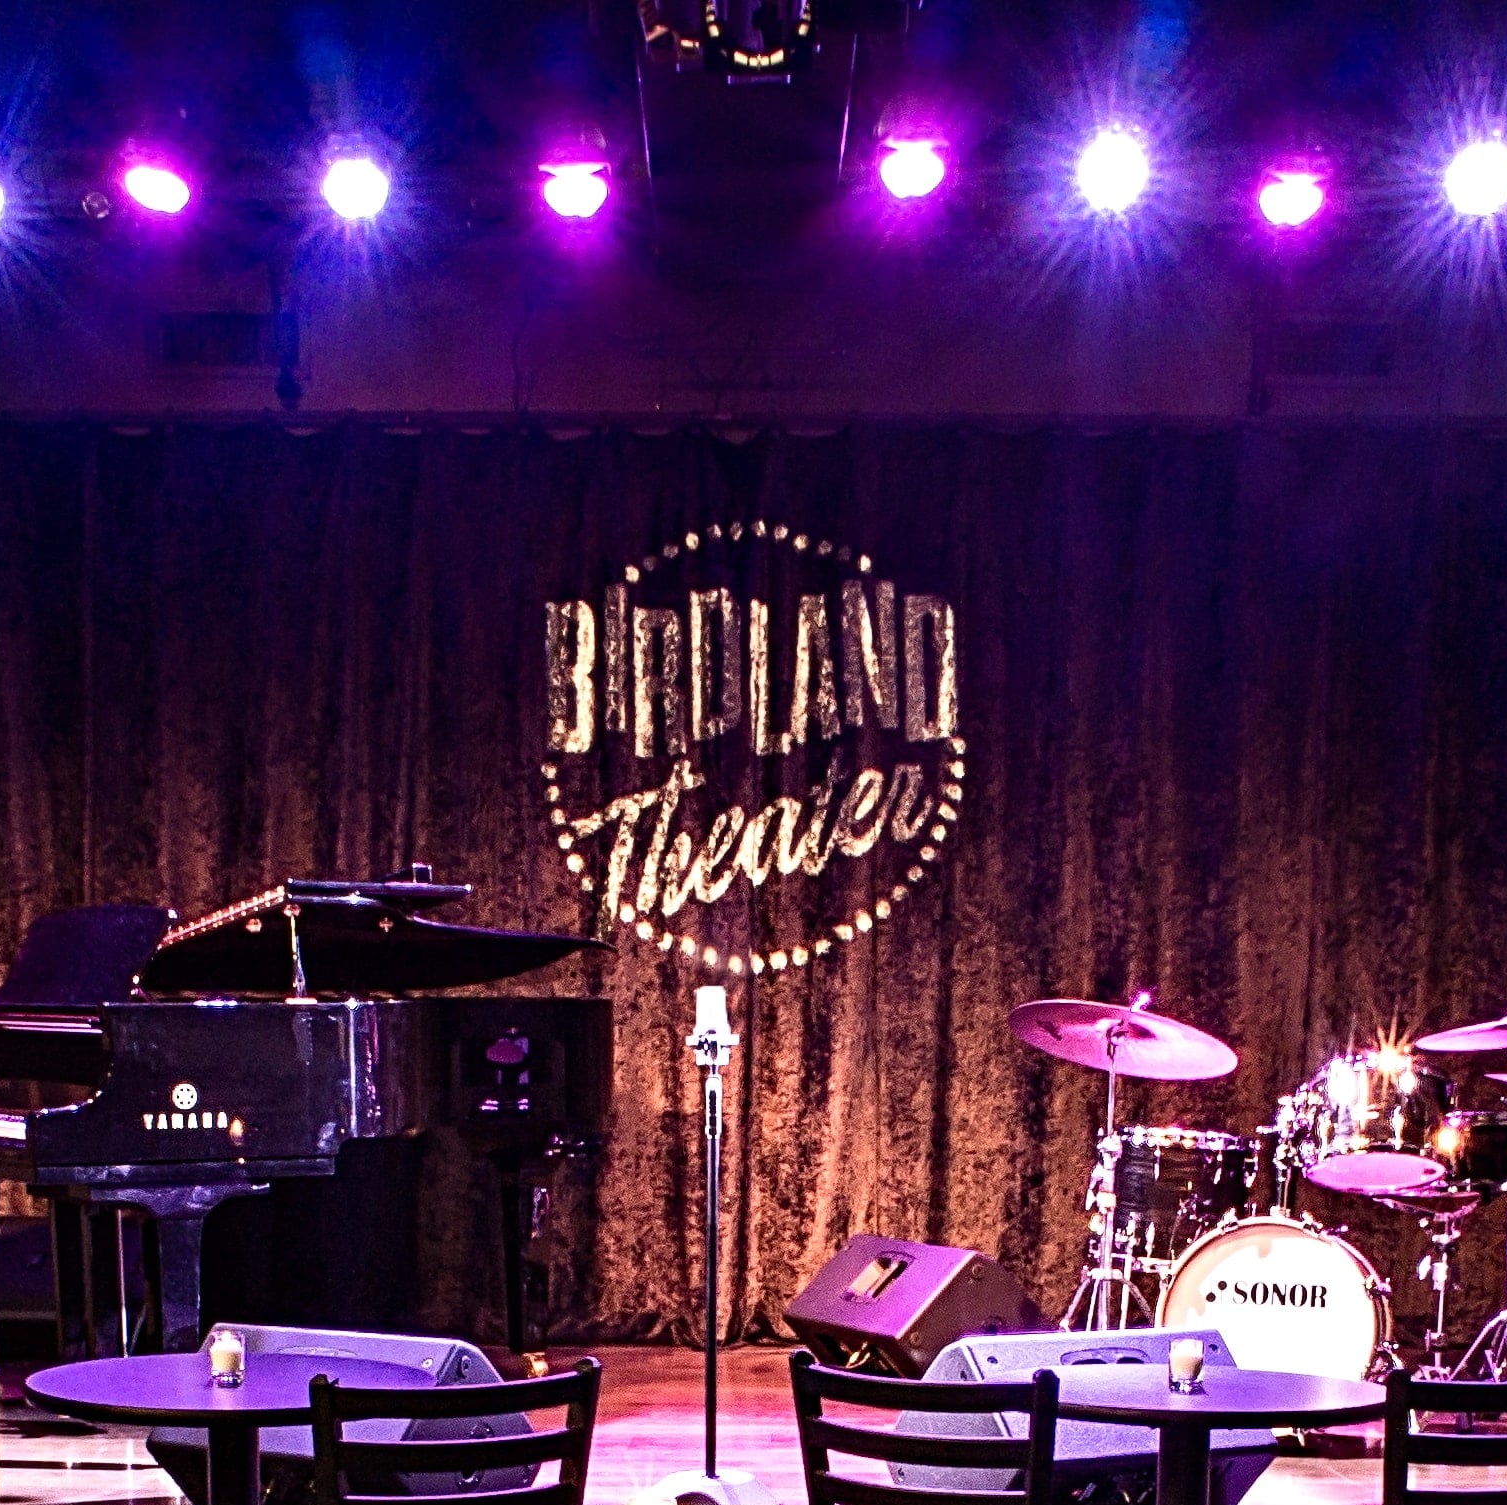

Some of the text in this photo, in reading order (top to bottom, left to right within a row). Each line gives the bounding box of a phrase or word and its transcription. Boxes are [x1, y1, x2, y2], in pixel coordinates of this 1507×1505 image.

[545, 581, 959, 757] BIRDLAND
[572, 757, 934, 934] Theater
[142, 1111, 228, 1130] YAMAHA
[1232, 1280, 1328, 1309] SONOR
